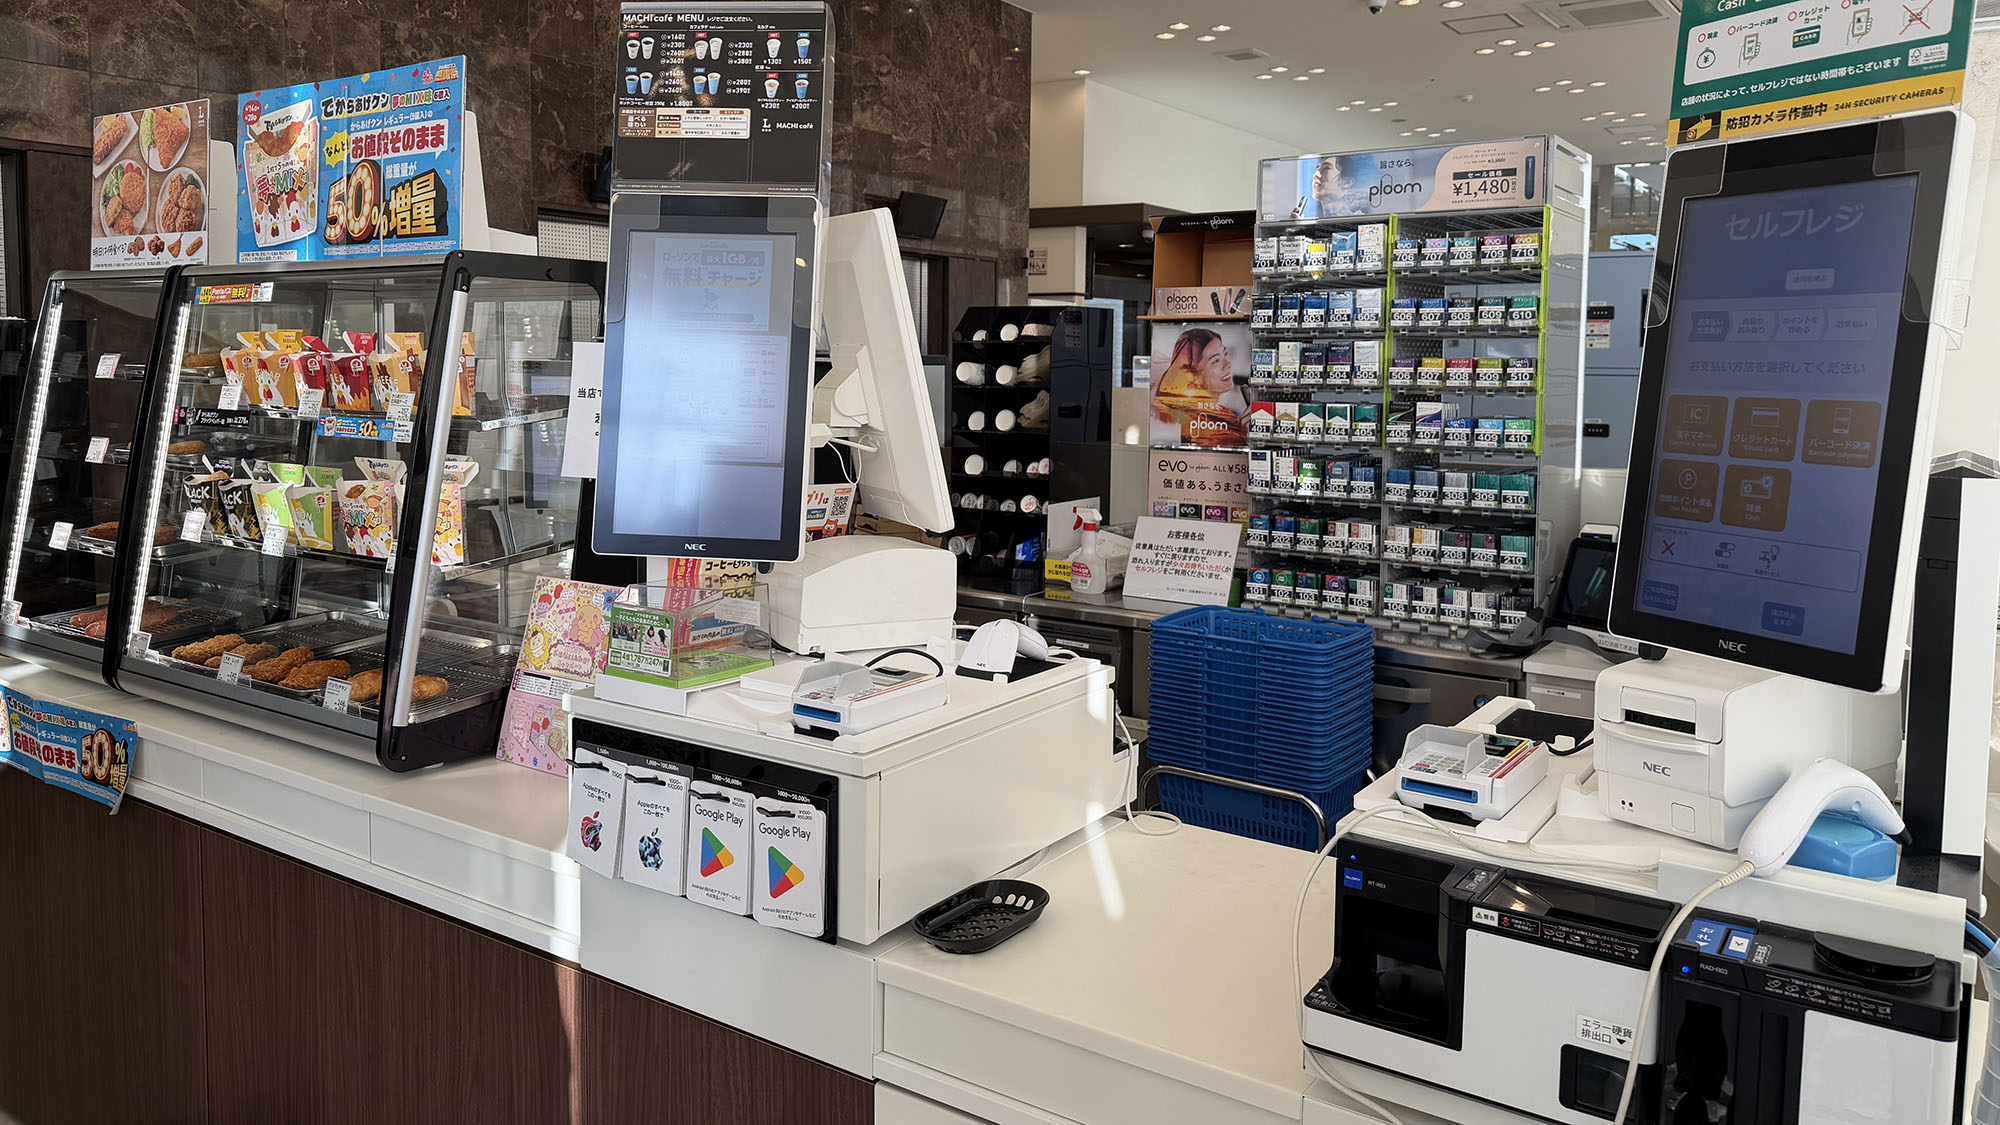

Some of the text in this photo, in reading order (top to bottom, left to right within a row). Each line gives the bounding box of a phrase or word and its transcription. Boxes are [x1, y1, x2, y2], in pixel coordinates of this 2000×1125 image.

[1798, 5, 1831, 17] クレジット
[623, 14, 652, 22] MACHI
[653, 13, 674, 22] café
[677, 14, 704, 22] MENU
[1803, 15, 1823, 24] カード
[321, 93, 390, 119] でからあげクン
[1725, 87, 1945, 131] 防犯カメラ作動中 24H SECURITY CAMERAS
[351, 124, 445, 159] お値段そのまま
[1369, 173, 1422, 208] ploom
[1453, 179, 1510, 198] ¥1,480
[323, 162, 437, 241] 50%増量
[1210, 216, 1234, 229] ploom
[1725, 203, 1865, 241] セルフレジ
[1484, 238, 1501, 246] evo
[1515, 236, 1532, 244] evo
[1454, 251, 1473, 259] 708
[1485, 250, 1504, 258] 709
[1516, 248, 1535, 257] 710
[1396, 253, 1414, 261] 706
[1424, 253, 1443, 261] 707
[1280, 258, 1297, 266] 702
[1306, 257, 1324, 266] 703
[662, 267, 763, 286] 無料チャージ
[1166, 289, 1198, 311] ploom
[1393, 312, 1412, 320] 606
[1421, 312, 1440, 320] 607
[1450, 312, 1471, 320] 608
[1481, 311, 1502, 319] 609
[1512, 311, 1532, 320] 610
[1688, 360, 1867, 375] お支払い方法を選択してください
[1252, 370, 1268, 378] 501
[1303, 371, 1320, 379] 503
[1356, 371, 1374, 379] 505
[1420, 372, 1439, 380] 507
[1449, 372, 1469, 380] 508
[1690, 409, 1703, 420] IC
[1190, 413, 1228, 438] ploom
[1354, 428, 1372, 436] 405
[1389, 430, 1408, 438] 406
[1418, 431, 1436, 439] 407
[1477, 434, 1498, 442] 409
[1509, 434, 1528, 442] 410
[1158, 460, 1188, 473] evo
[1352, 486, 1371, 494] 305
[1388, 488, 1407, 496] 306
[1415, 490, 1434, 498] 307
[1444, 492, 1465, 500] 308
[1475, 493, 1495, 501] 309
[1506, 495, 1525, 504] 310
[1206, 508, 1221, 516] evo
[1167, 531, 1205, 540] お客様各位
[1273, 535, 1291, 544] 202
[1299, 538, 1316, 546] 203
[1324, 540, 1342, 548] 204
[684, 543, 707, 551] NEC
[1154, 552, 1208, 563] すぐに戻りますので、
[1444, 550, 1463, 558] 208
[1474, 553, 1494, 561] 209
[1504, 556, 1523, 564] 210
[1135, 565, 1223, 580] セルフレジをご利用くださいませ。
[1352, 599, 1369, 607] 105
[1444, 609, 1462, 617] 108
[1474, 612, 1493, 621] 109
[1718, 639, 1748, 653] NEC
[1642, 761, 1672, 777] NEC
[694, 804, 744, 828] Google Play
[758, 823, 811, 842] Google Play
[1699, 962, 1729, 976] RAD-R03
[1581, 1018, 1633, 1040] エラー硬貨
[1581, 1027, 1612, 1044] 排出口
